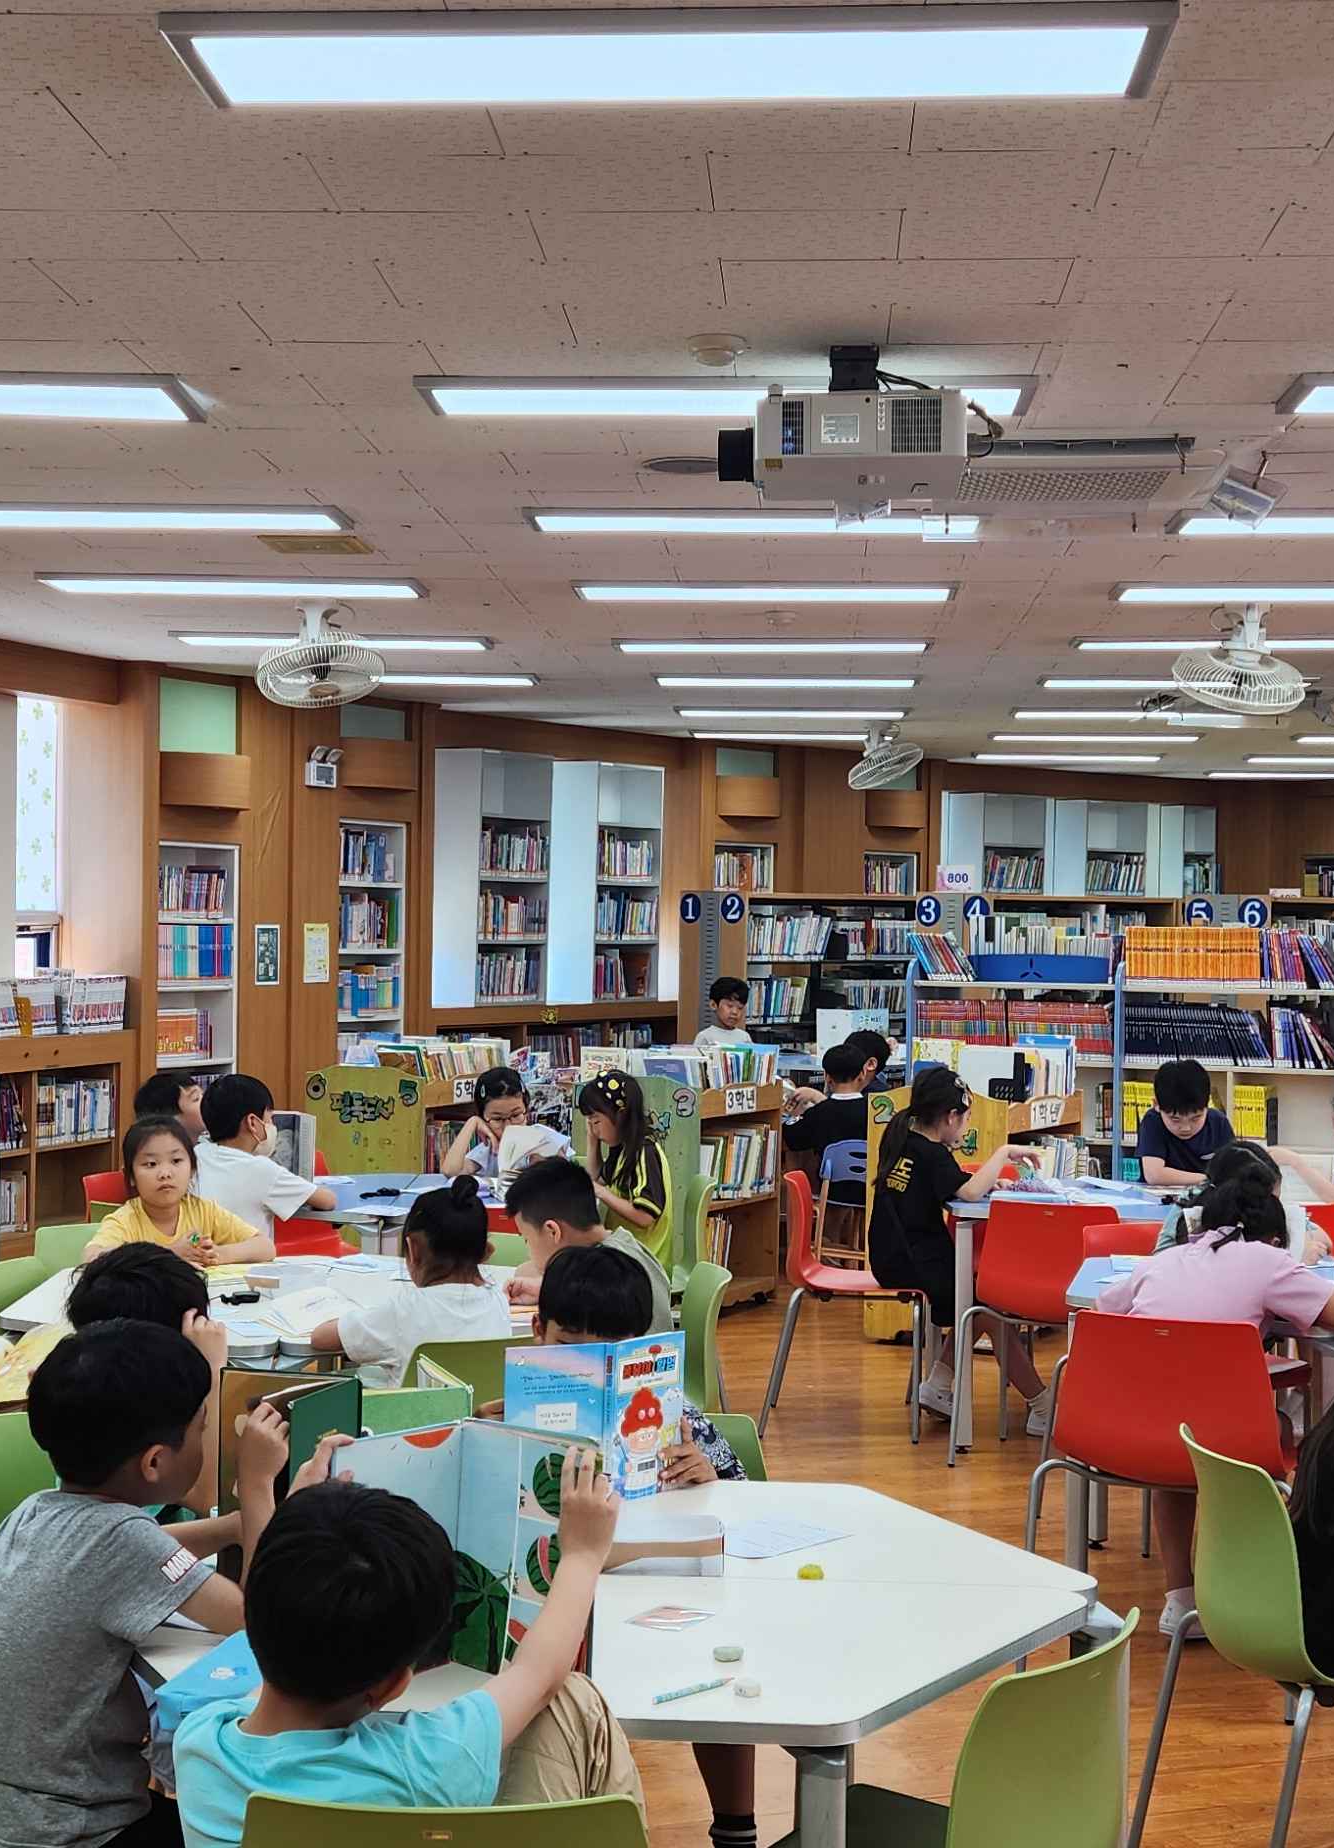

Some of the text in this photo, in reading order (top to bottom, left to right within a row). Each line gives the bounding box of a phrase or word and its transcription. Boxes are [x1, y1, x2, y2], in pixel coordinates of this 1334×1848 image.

[948, 872, 969, 884] 800
[684, 897, 696, 920] 1
[726, 897, 741, 920] 2
[921, 898, 937, 923] 3
[967, 898, 981, 918] 4
[1191, 901, 1209, 919] 5
[1243, 901, 1262, 925] 6
[305, 1072, 327, 1100] 6
[398, 1079, 419, 1107] 5
[672, 1087, 697, 1118] 3
[727, 1089, 756, 1112] 3학년
[870, 1094, 896, 1125] 2
[1031, 1100, 1061, 1124] 1학년
